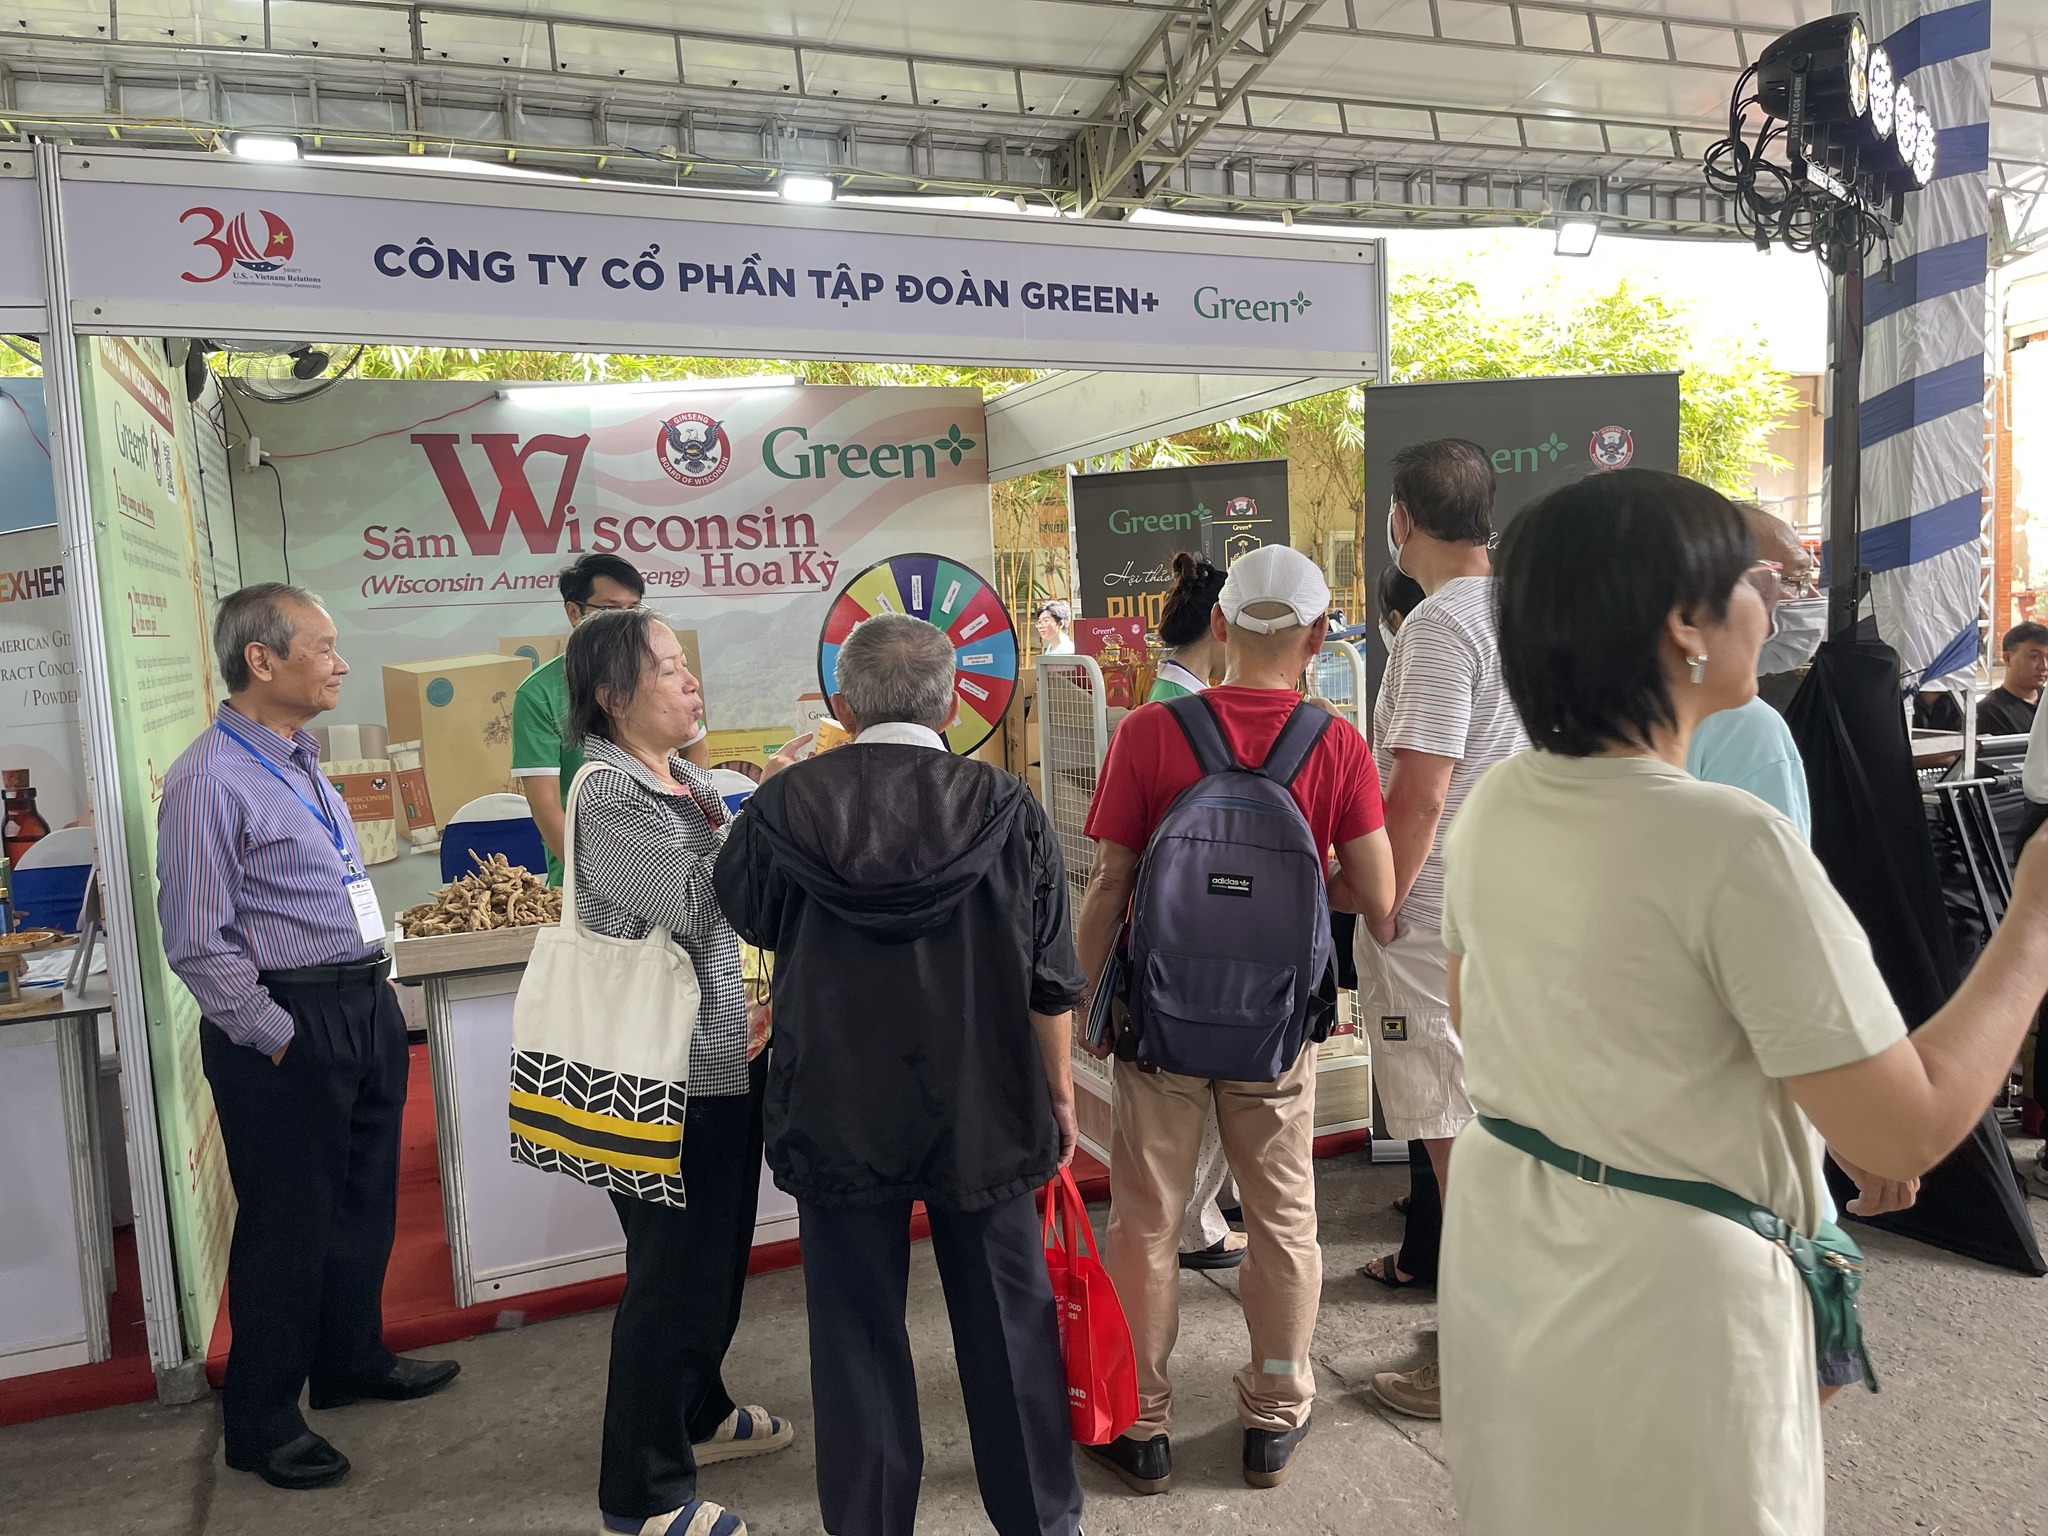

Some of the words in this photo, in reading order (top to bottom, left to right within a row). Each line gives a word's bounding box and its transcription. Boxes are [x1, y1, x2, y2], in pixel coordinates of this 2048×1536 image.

[287, 275, 321, 283] Relations
[373, 236, 515, 284] CÔNG
[528, 253, 588, 287] TY
[601, 243, 665, 291] CỔ
[679, 252, 796, 298] PHẦN
[807, 262, 884, 308] TẬP
[895, 269, 1009, 308] ĐOÀN
[1020, 281, 1160, 315] GREEN+
[673, 413, 709, 424] GINSENG
[660, 456, 681, 480] BOARD
[681, 476, 693, 485] OF
[694, 456, 729, 485] WISCONSIN
[410, 433, 819, 556] Wisconsin
[362, 525, 459, 561] Sâm
[701, 553, 790, 589] Hoa
[791, 550, 840, 592] Kỳ
[1103, 560, 1143, 586] Hội
[361, 572, 484, 599] (Wisconsin
[39, 660, 75, 678] CONC
[32, 689, 78, 706] POWDE
